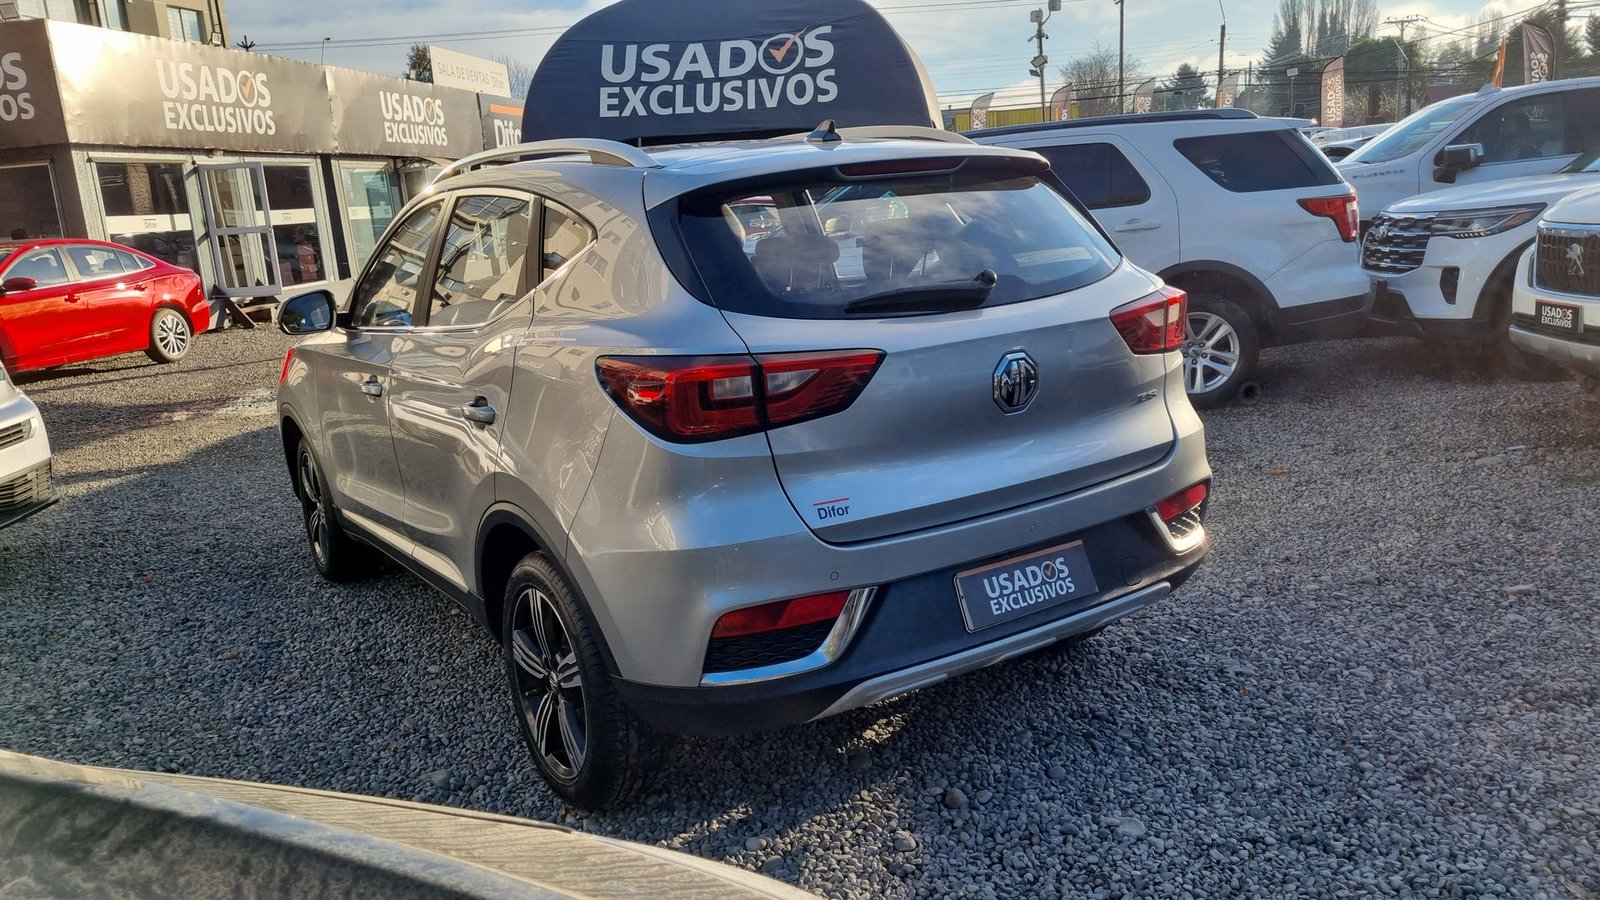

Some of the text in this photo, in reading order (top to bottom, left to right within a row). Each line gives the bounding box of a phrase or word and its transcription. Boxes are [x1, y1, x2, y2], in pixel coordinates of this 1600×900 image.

[599, 25, 834, 83] USADOS
[156, 59, 271, 108] USADOS
[437, 62, 456, 78] SALA
[456, 66, 465, 80] DE
[466, 69, 490, 85] VENTAS
[379, 90, 445, 126] USADOS
[599, 69, 838, 118] EXCLUSIVOS
[1327, 77, 1336, 122] USADOS
[162, 100, 276, 136] EXCLUSIVOS
[383, 121, 448, 147] EXCLUSIVOS
[1541, 305, 1573, 320] USADOS
[1541, 315, 1572, 329] EXCLUSIVOS
[998, 357, 1036, 408] MG
[817, 505, 850, 520] Difor
[983, 557, 1069, 598] USADOS
[989, 577, 1075, 616] EXCLUSIVOS
